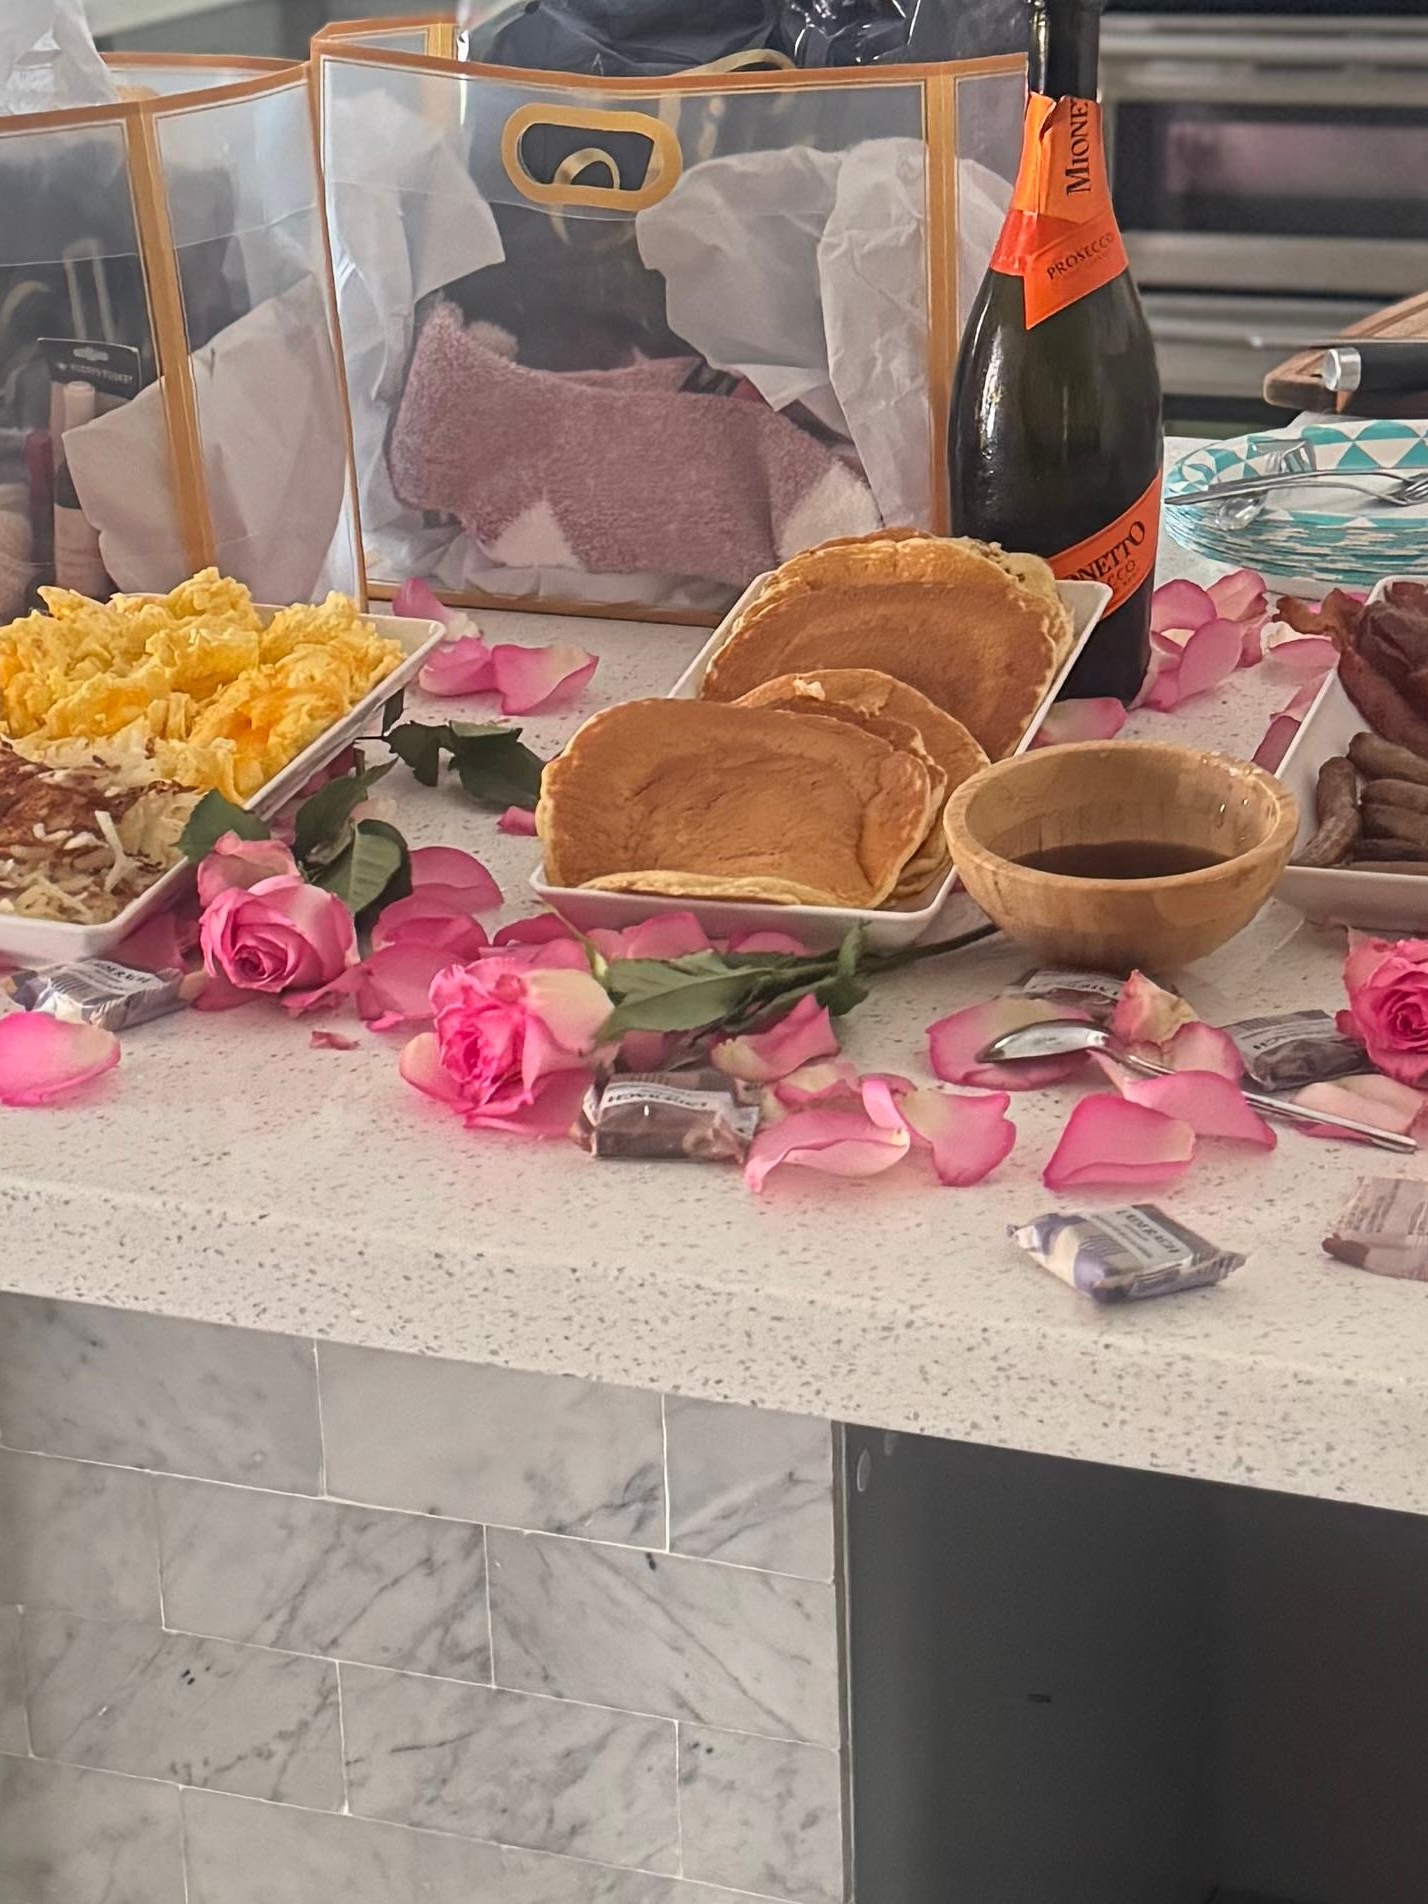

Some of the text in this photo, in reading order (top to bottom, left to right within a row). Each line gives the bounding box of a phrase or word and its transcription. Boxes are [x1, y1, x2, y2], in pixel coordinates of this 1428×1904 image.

[1064, 99, 1091, 196] MIONE
[1046, 231, 1115, 281] PROSECCO
[1066, 520, 1146, 581] NETTO
